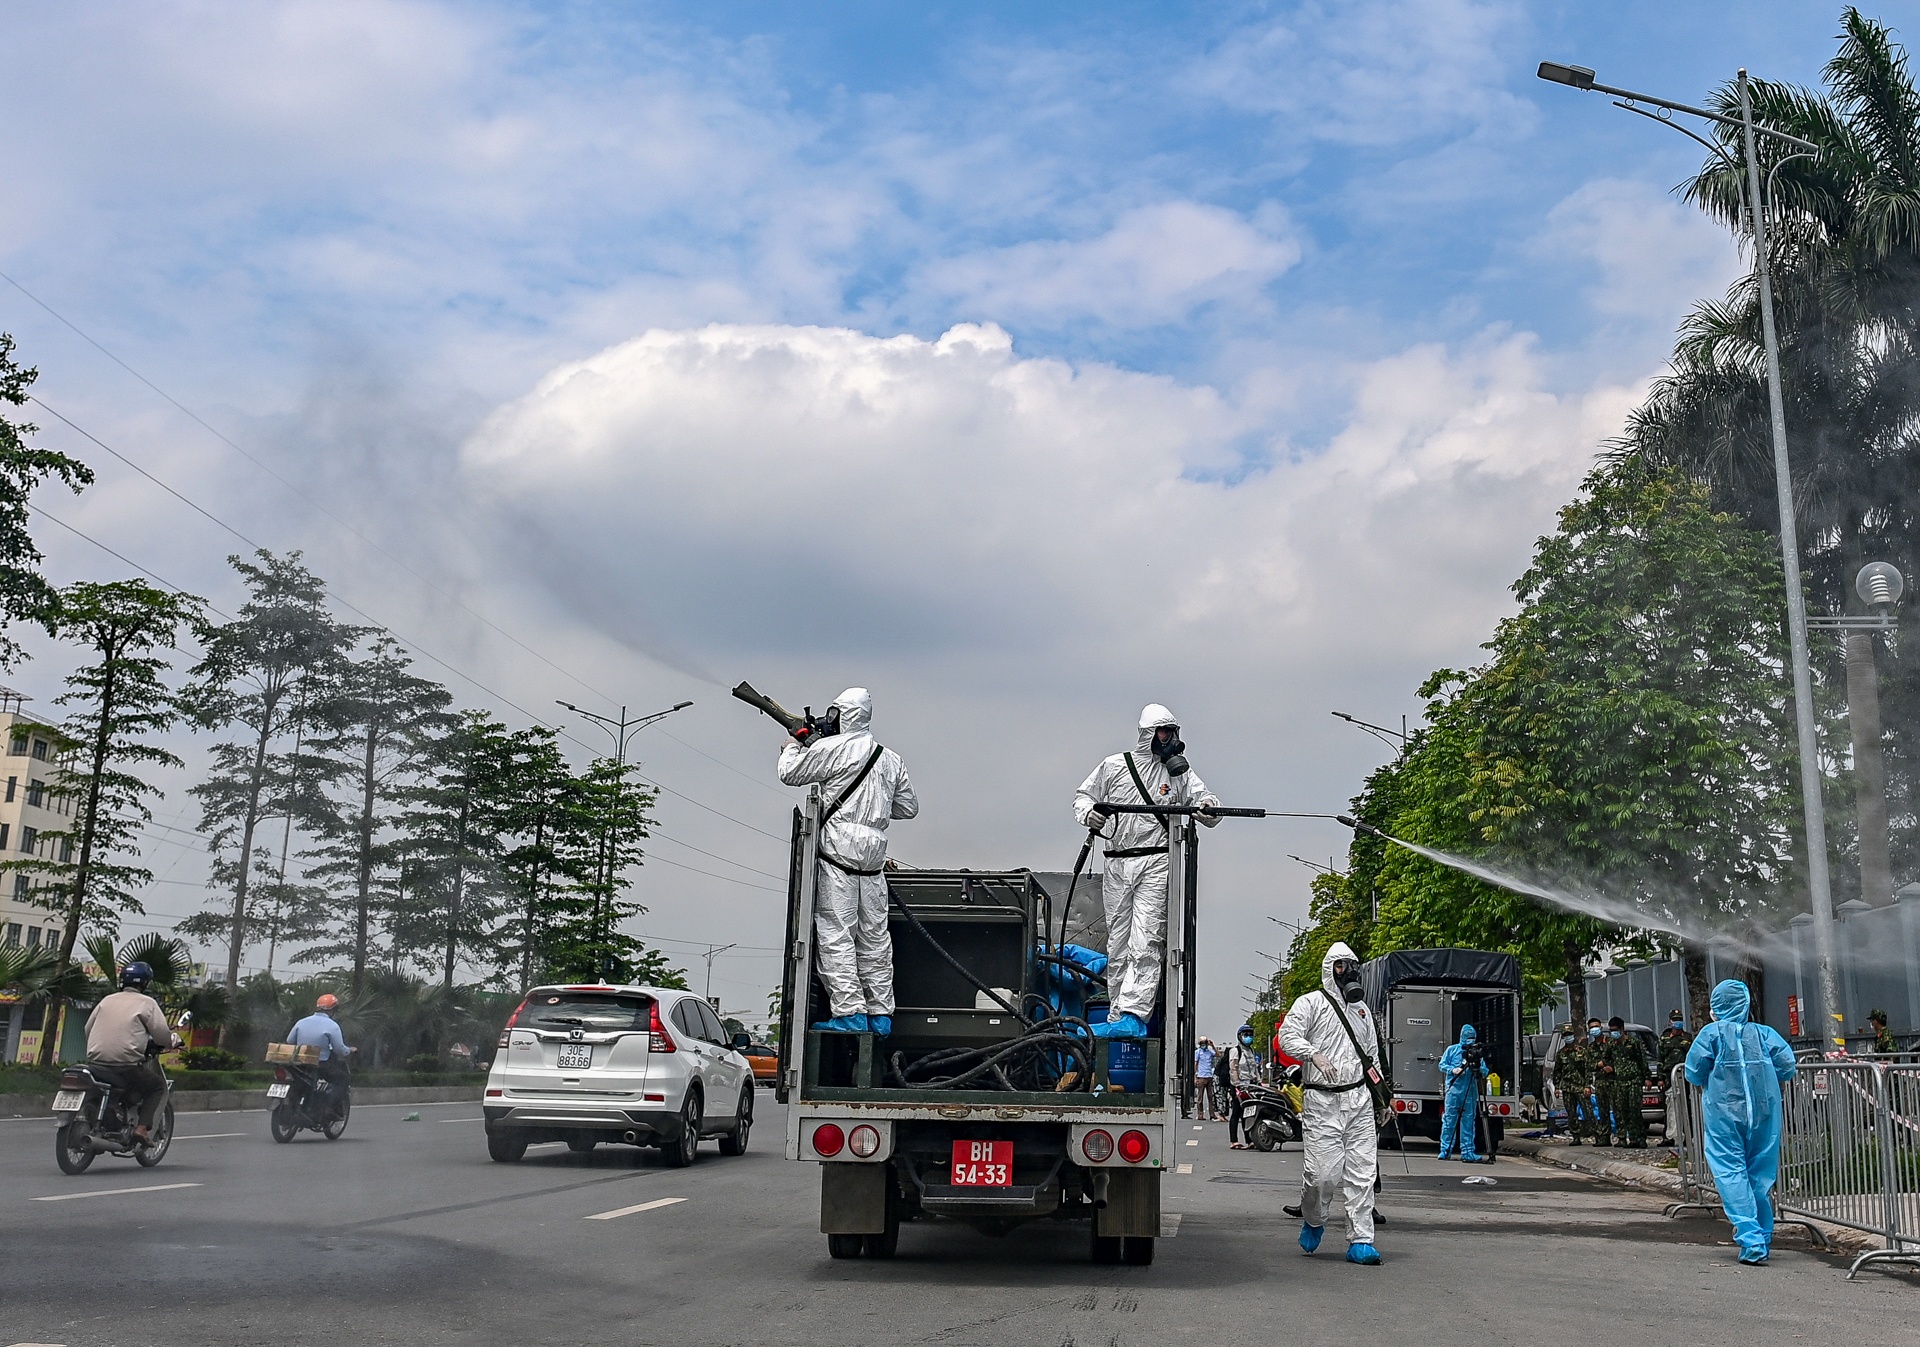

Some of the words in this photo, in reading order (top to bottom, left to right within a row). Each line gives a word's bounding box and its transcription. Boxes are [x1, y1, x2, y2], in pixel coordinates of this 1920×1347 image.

[567, 1045, 585, 1056] 30E
[559, 1055, 589, 1067] 883.66
[970, 1141, 993, 1162] BH
[955, 1163, 1007, 1185] 54-33
